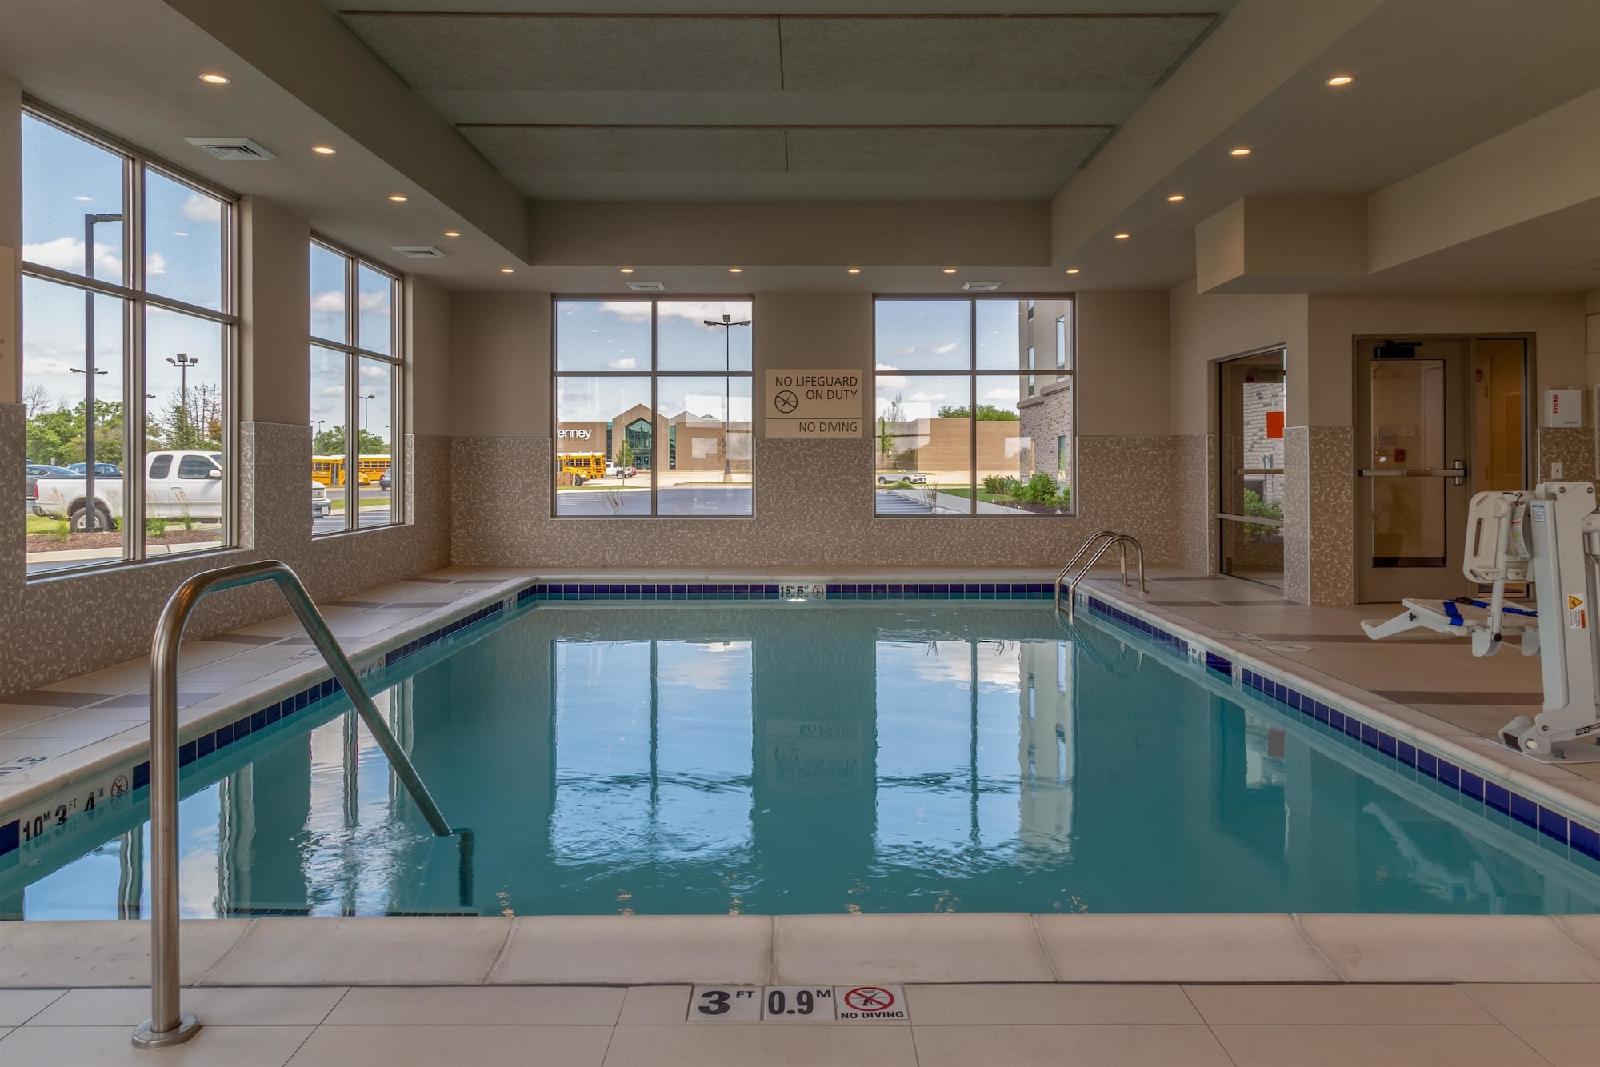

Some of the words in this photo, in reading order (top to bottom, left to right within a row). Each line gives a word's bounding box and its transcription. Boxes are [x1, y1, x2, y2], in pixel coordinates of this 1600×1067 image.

[775, 376, 792, 387] NO
[796, 376, 858, 387] LIFEGUARD
[805, 389, 823, 400] ON
[826, 389, 858, 400] DUTY
[799, 421, 816, 433] NO
[819, 421, 858, 433] DIVING
[557, 429, 592, 440] enney
[54, 804, 68, 826] 3
[698, 990, 731, 1015] 3
[736, 991, 756, 999] FT
[768, 990, 814, 1015] 0.9
[816, 989, 831, 998] M
[840, 1011, 858, 1019] NO
[861, 1011, 904, 1019] DIVING
